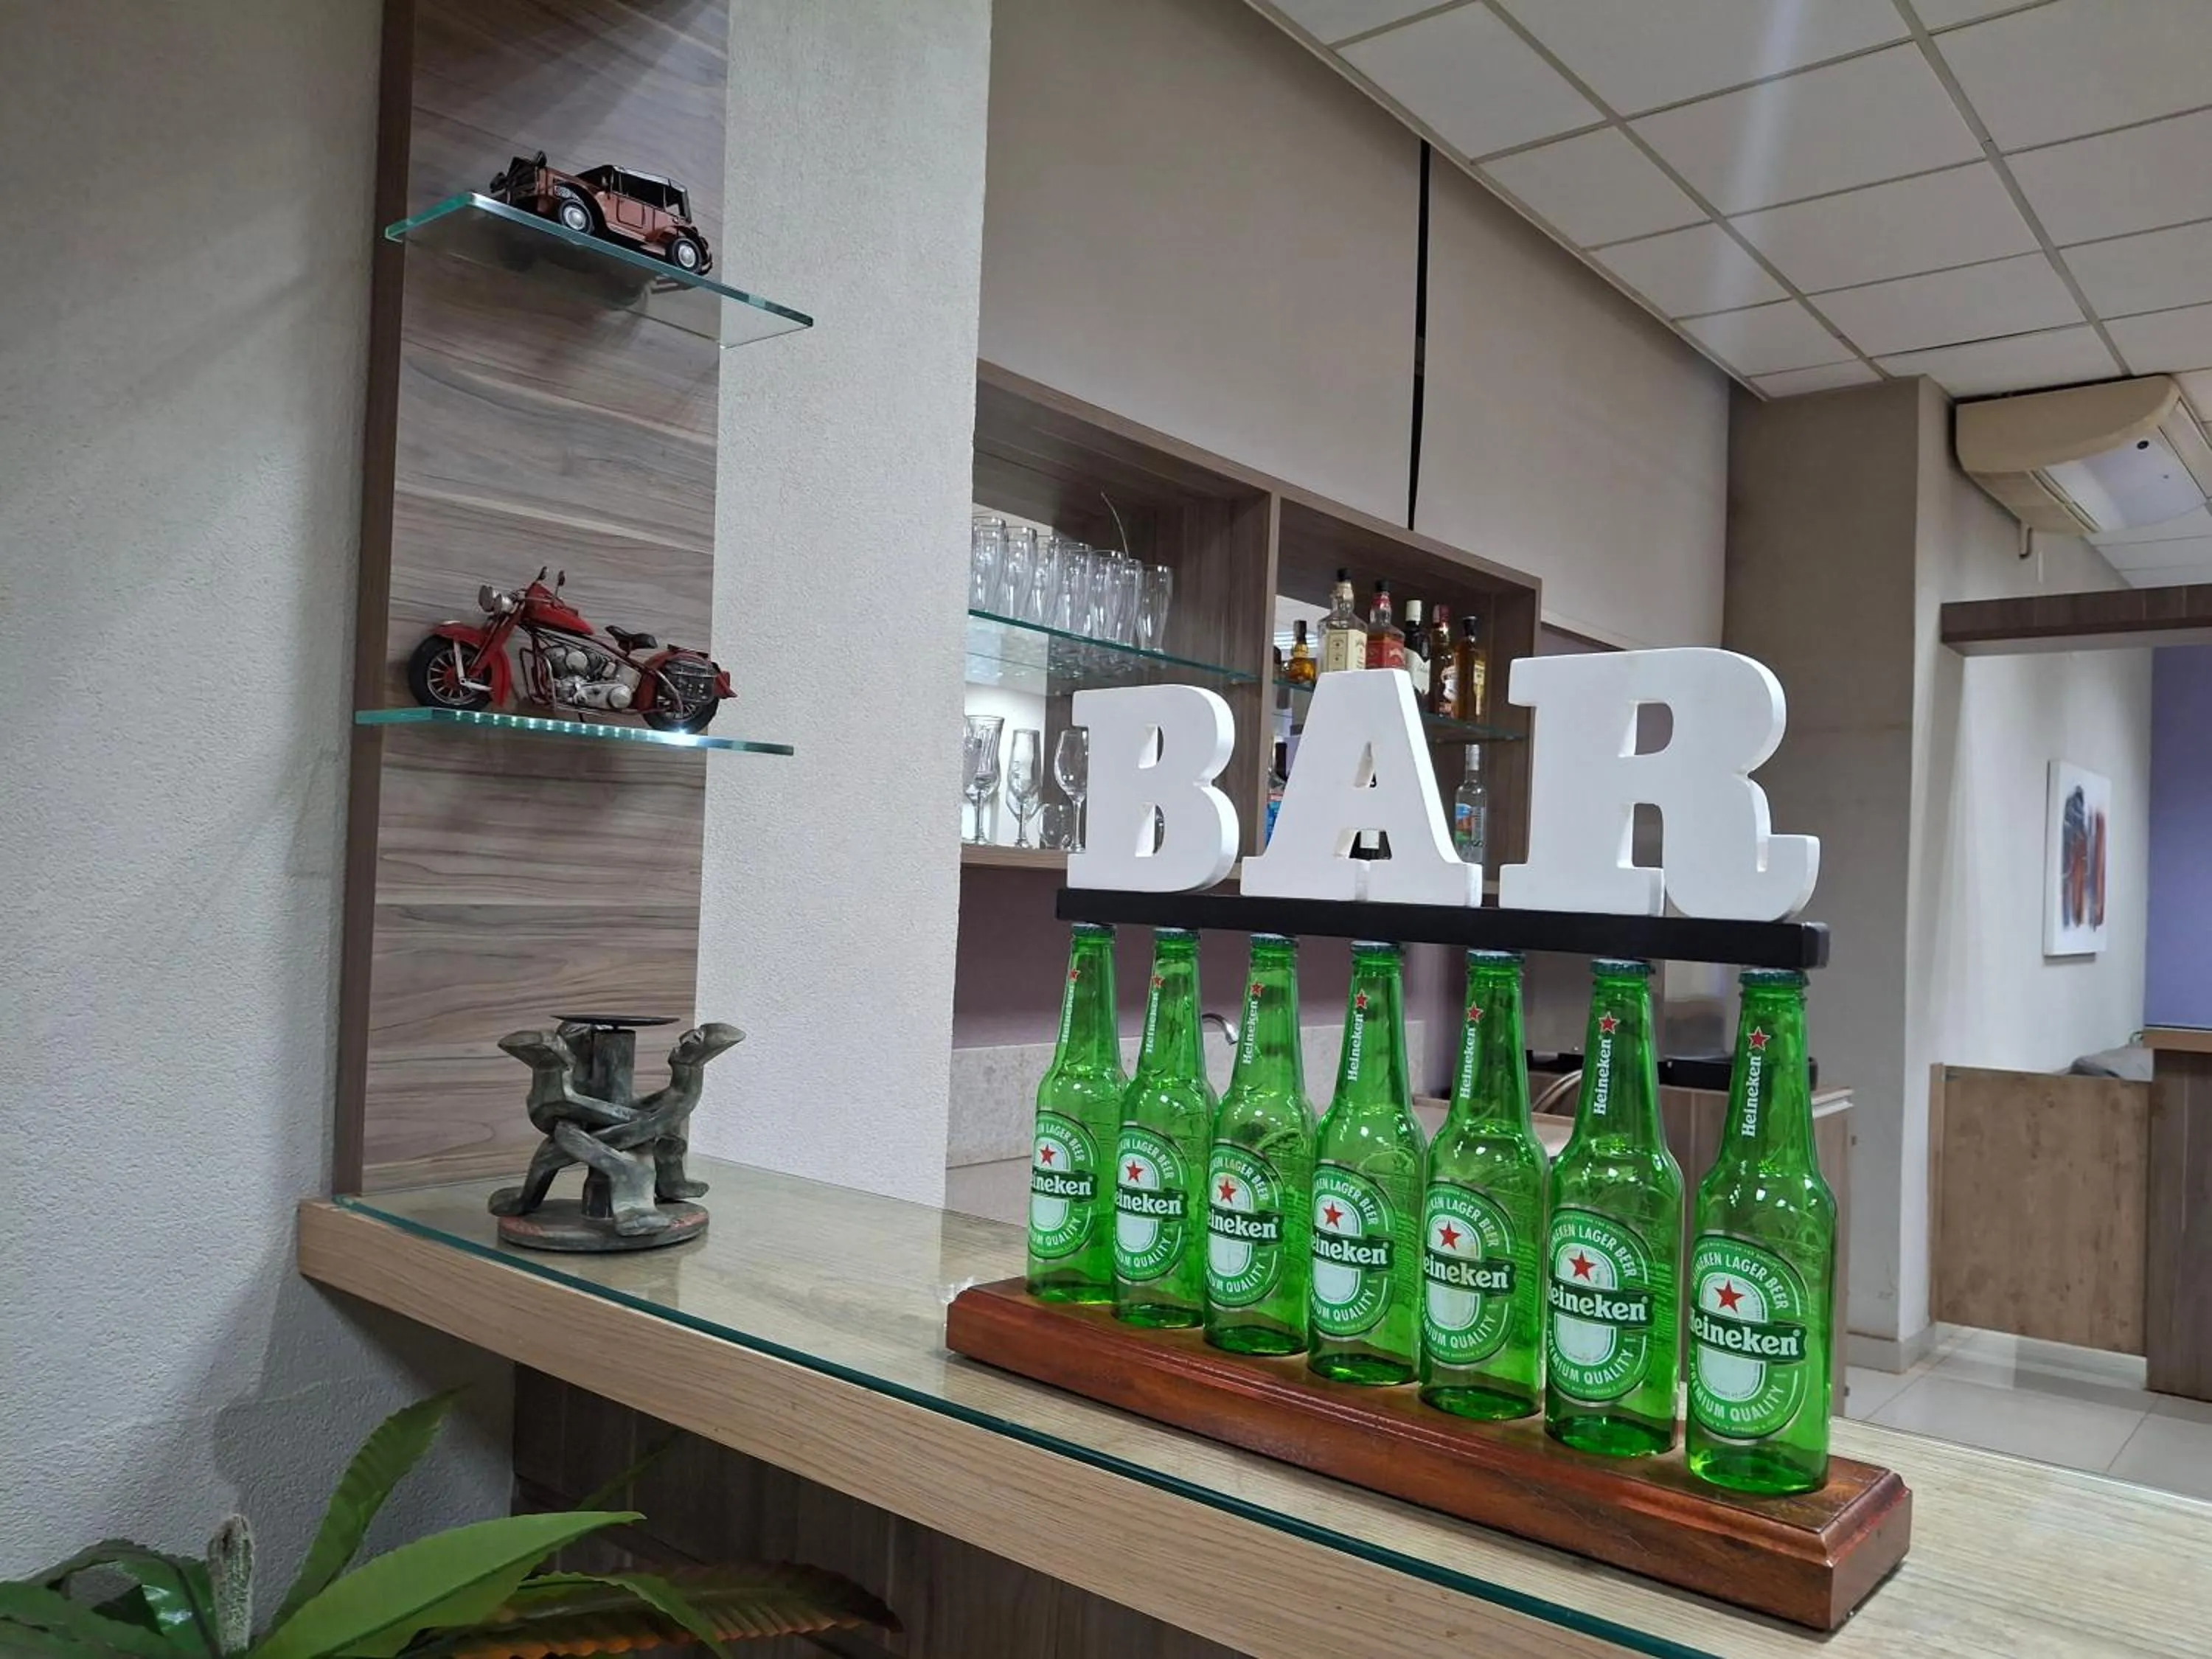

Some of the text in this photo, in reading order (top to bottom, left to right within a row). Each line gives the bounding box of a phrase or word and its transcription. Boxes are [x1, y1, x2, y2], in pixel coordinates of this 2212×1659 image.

[1067, 647, 1820, 921] BAR
[1242, 1000, 1259, 1065] Heineken
[1348, 1013, 1364, 1082] Heineken
[1459, 1027, 1476, 1099] Heineken
[1593, 1038, 1612, 1116] Heineken
[1741, 1055, 1761, 1138] Heineken
[1115, 1188, 1183, 1215] eineken
[1329, 1178, 1362, 1203] LAGER
[1359, 1197, 1379, 1225] BEER
[1446, 1197, 1481, 1222] LAGER
[1478, 1217, 1500, 1248] BEER
[1311, 1232, 1388, 1265] eineken
[1424, 1253, 1509, 1289] eineken
[1579, 1225, 1618, 1251] LAGER
[1614, 1245, 1638, 1278] BEER
[1332, 1289, 1376, 1322] QUALITY
[1725, 1253, 1768, 1281] LAGER
[1764, 1276, 1790, 1310] BEER
[1450, 1313, 1496, 1349] QUALITY
[1583, 1348, 1635, 1385] QUALITY
[1730, 1384, 1784, 1422] QUALITY
